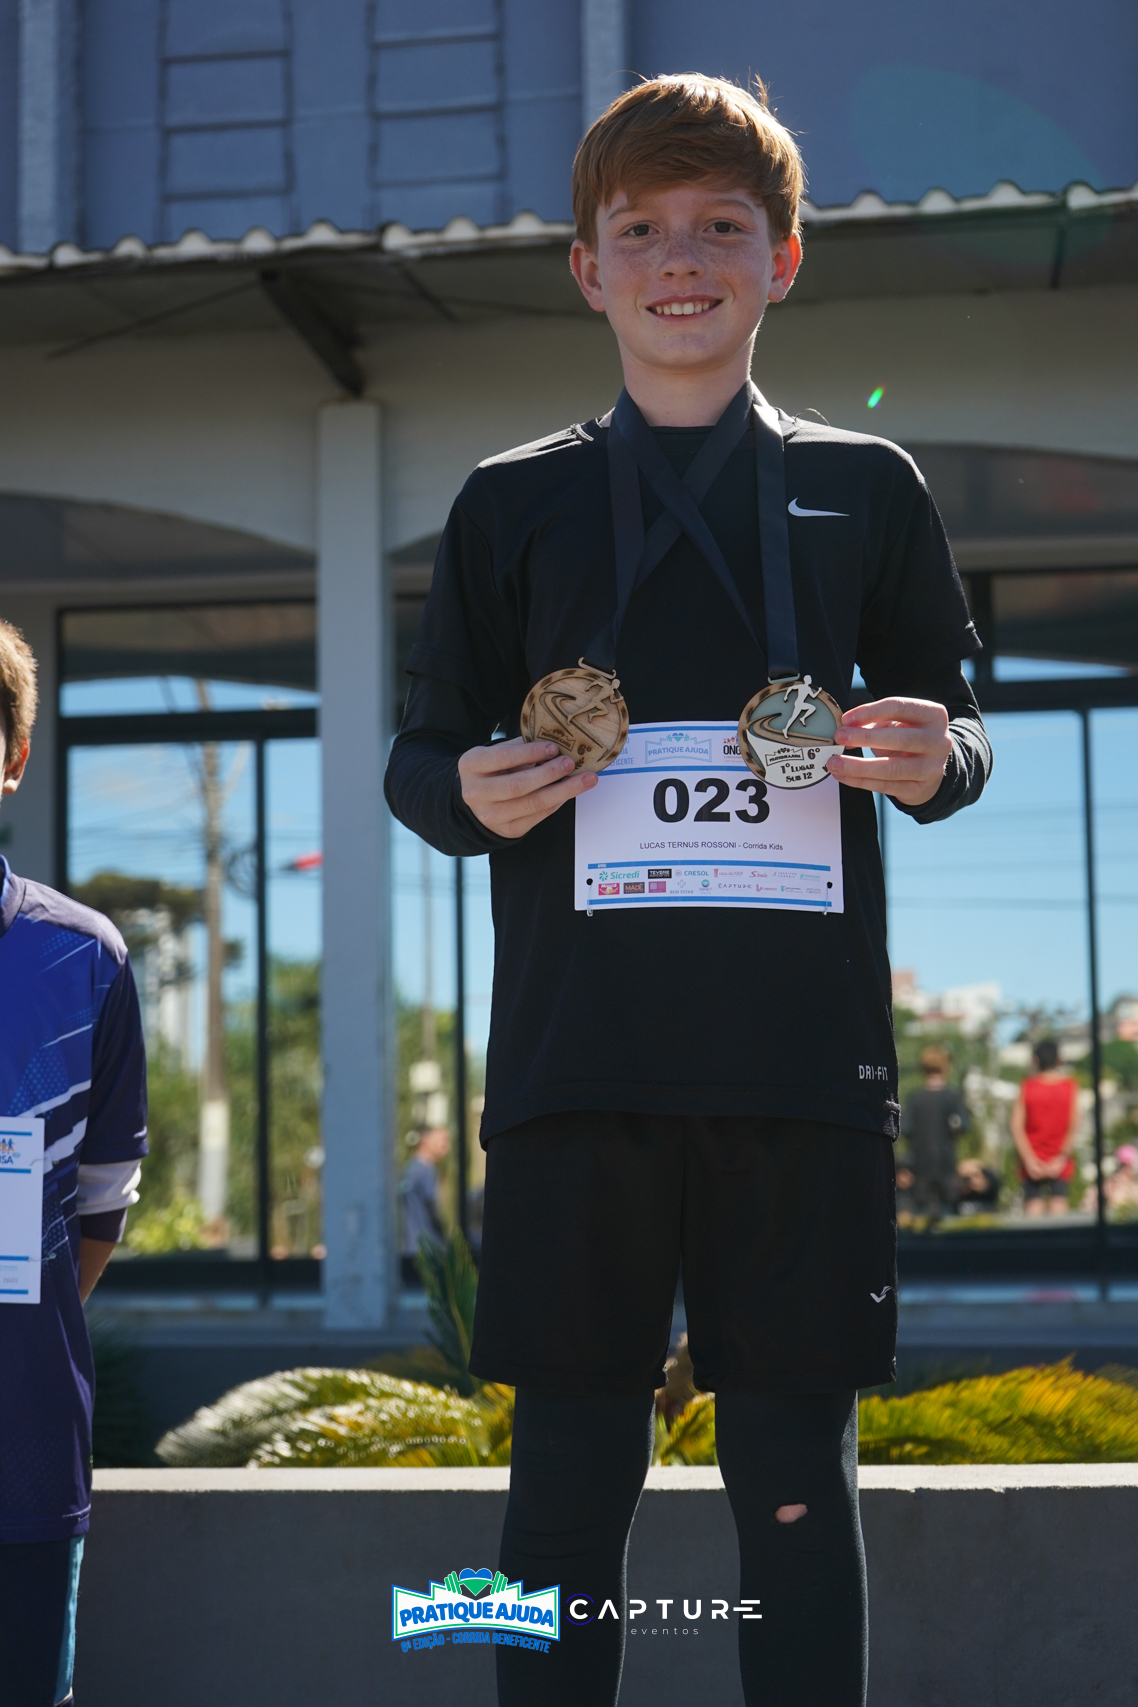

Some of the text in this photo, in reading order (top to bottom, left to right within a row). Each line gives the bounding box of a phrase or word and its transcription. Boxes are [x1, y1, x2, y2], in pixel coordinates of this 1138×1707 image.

[648, 746, 709, 756] PRATIQUE AJUDA
[802, 772, 812, 780] 12
[653, 778, 770, 824] 023
[701, 841, 737, 849] ROSSONI
[743, 842, 768, 850] Corrida
[610, 871, 640, 880] Sicredi
[858, 1065, 888, 1080] DRI-FIT
